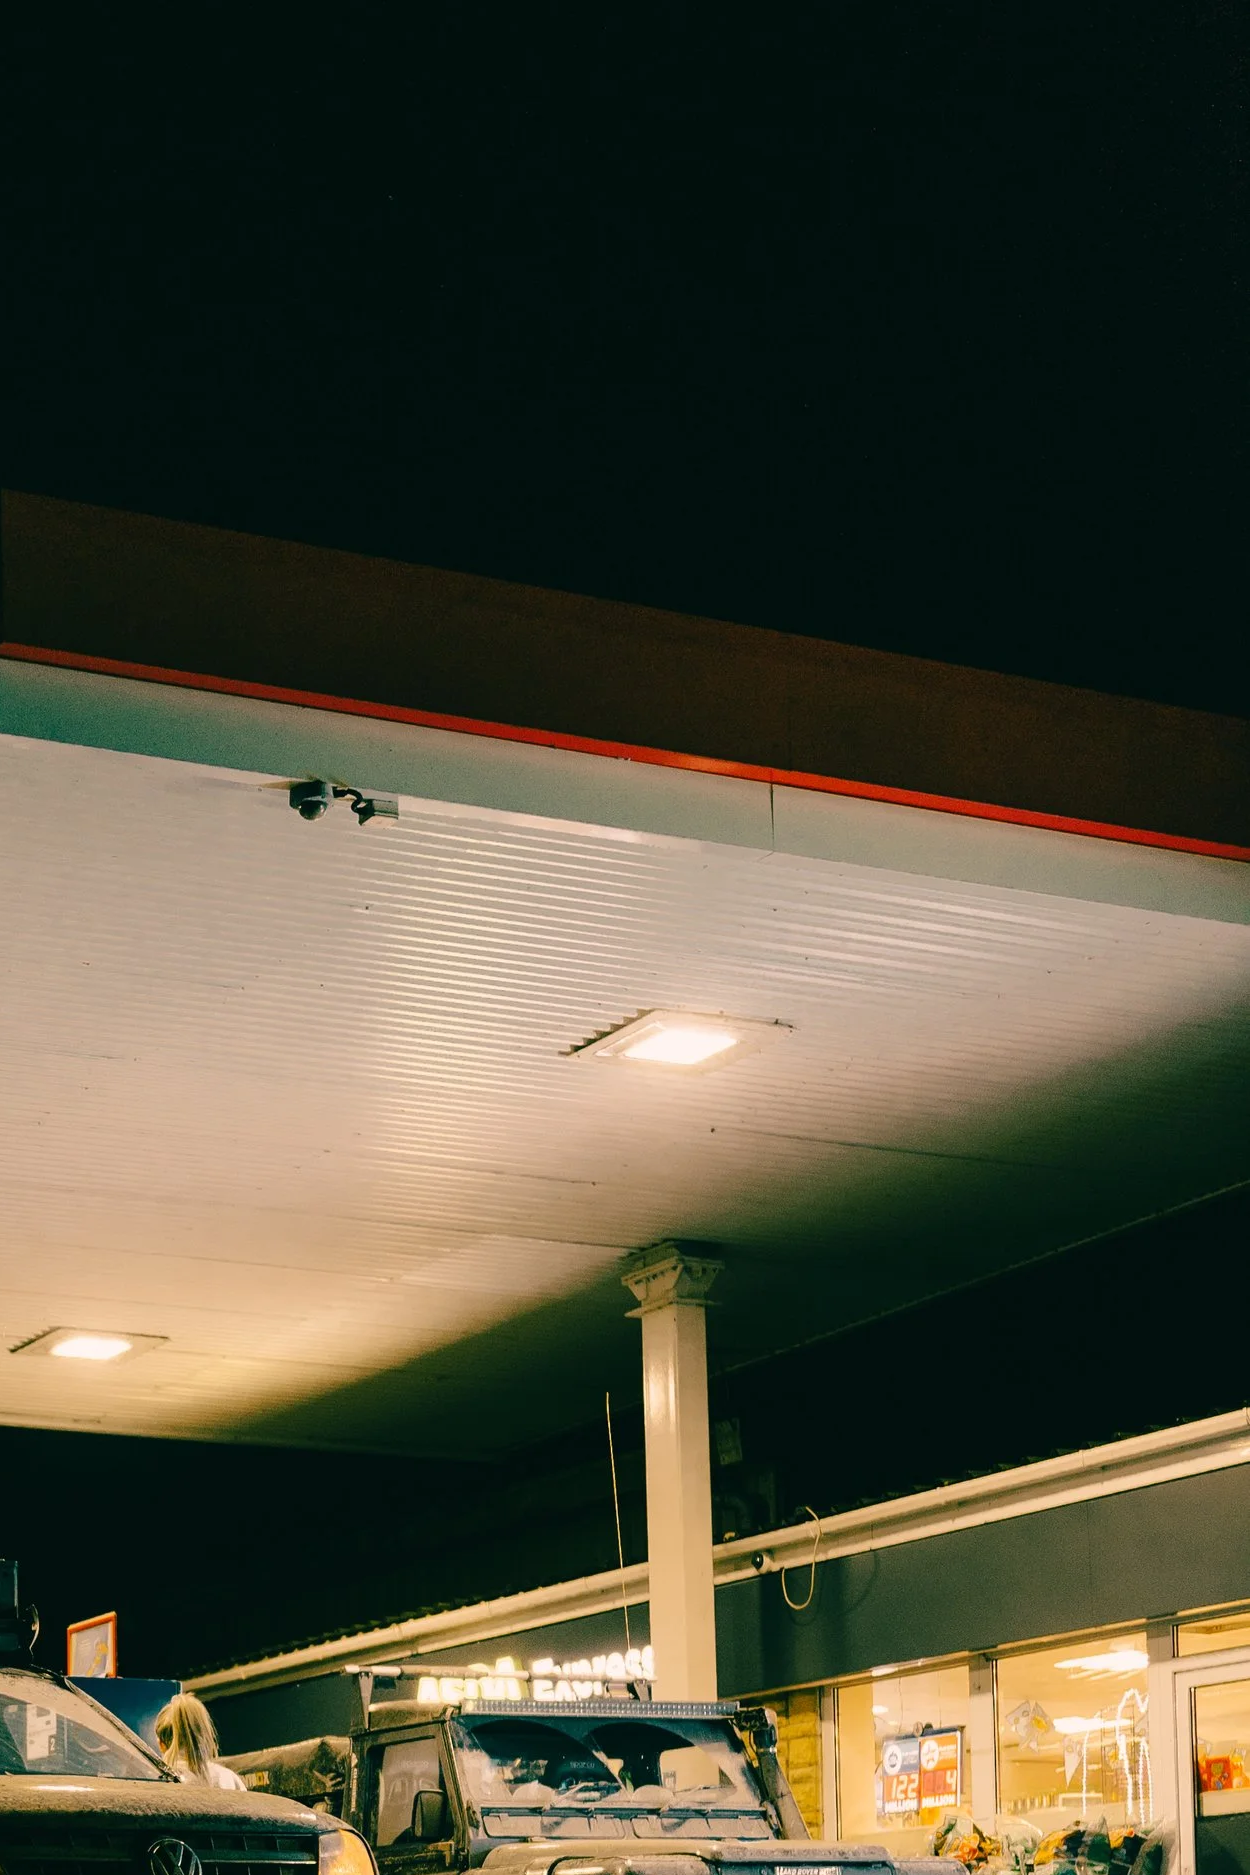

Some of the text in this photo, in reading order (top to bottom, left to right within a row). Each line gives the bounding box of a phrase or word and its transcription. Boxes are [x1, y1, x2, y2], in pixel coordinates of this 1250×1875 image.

[892, 1773, 919, 1799] 122
[884, 1798, 919, 1813] MILLION
[921, 1794, 957, 1809] MILLION
